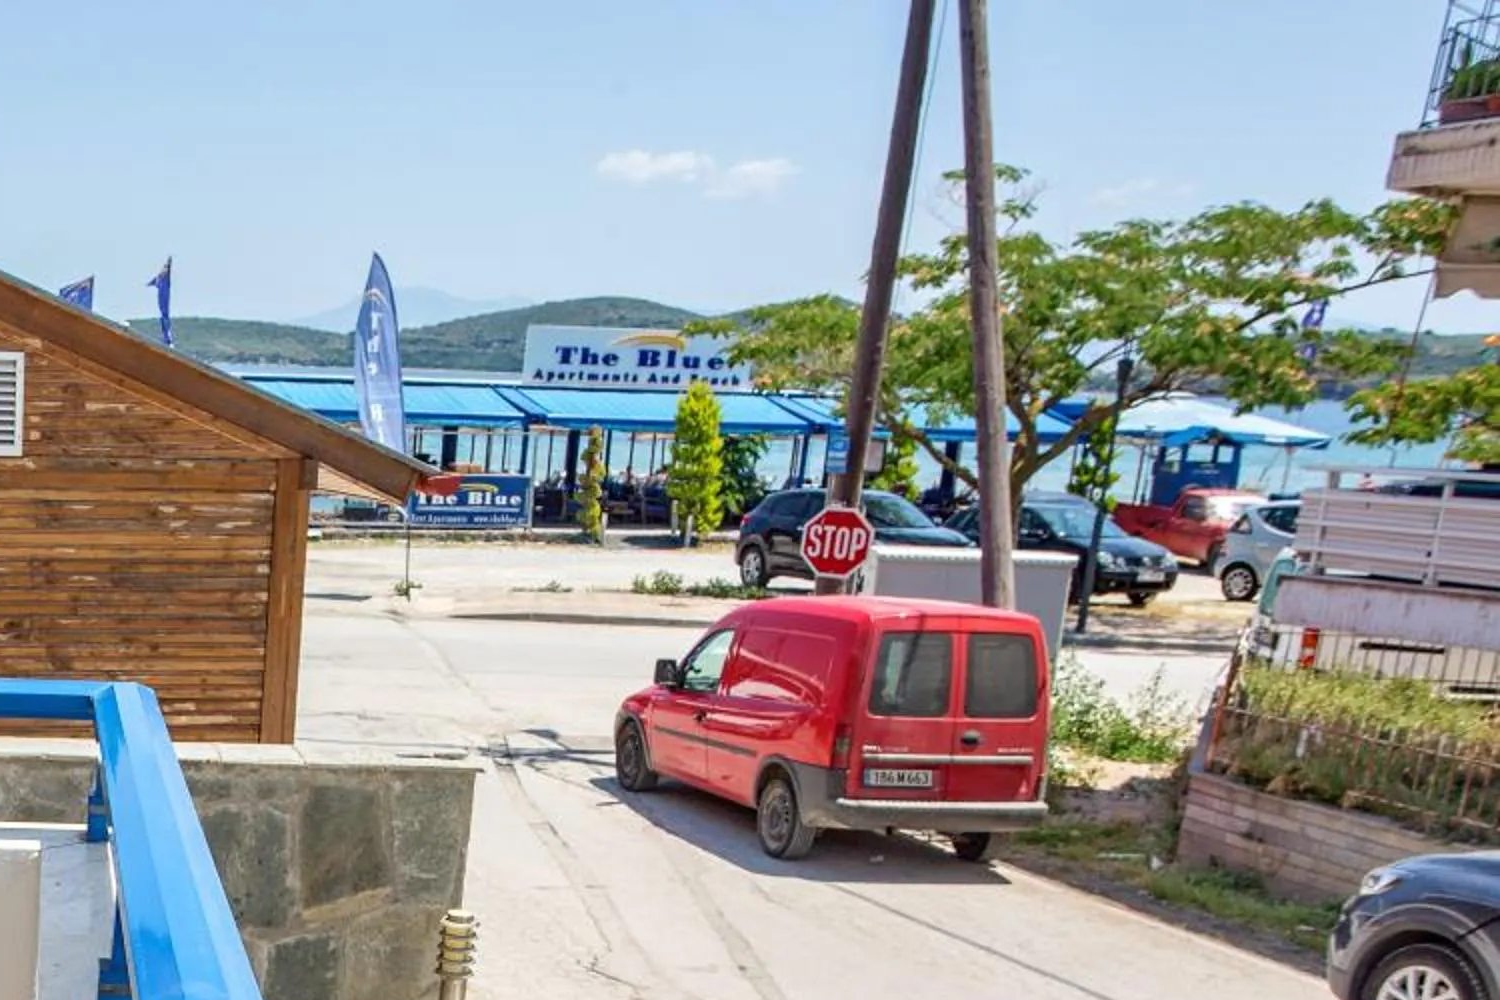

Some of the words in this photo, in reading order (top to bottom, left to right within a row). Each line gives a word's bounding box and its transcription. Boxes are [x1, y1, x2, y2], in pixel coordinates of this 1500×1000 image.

[555, 346, 619, 366] The
[636, 348, 724, 371] Blue
[532, 368, 638, 382] Apartments
[647, 372, 680, 384] And
[467, 491, 522, 505] Blue
[807, 523, 867, 561] STOP
